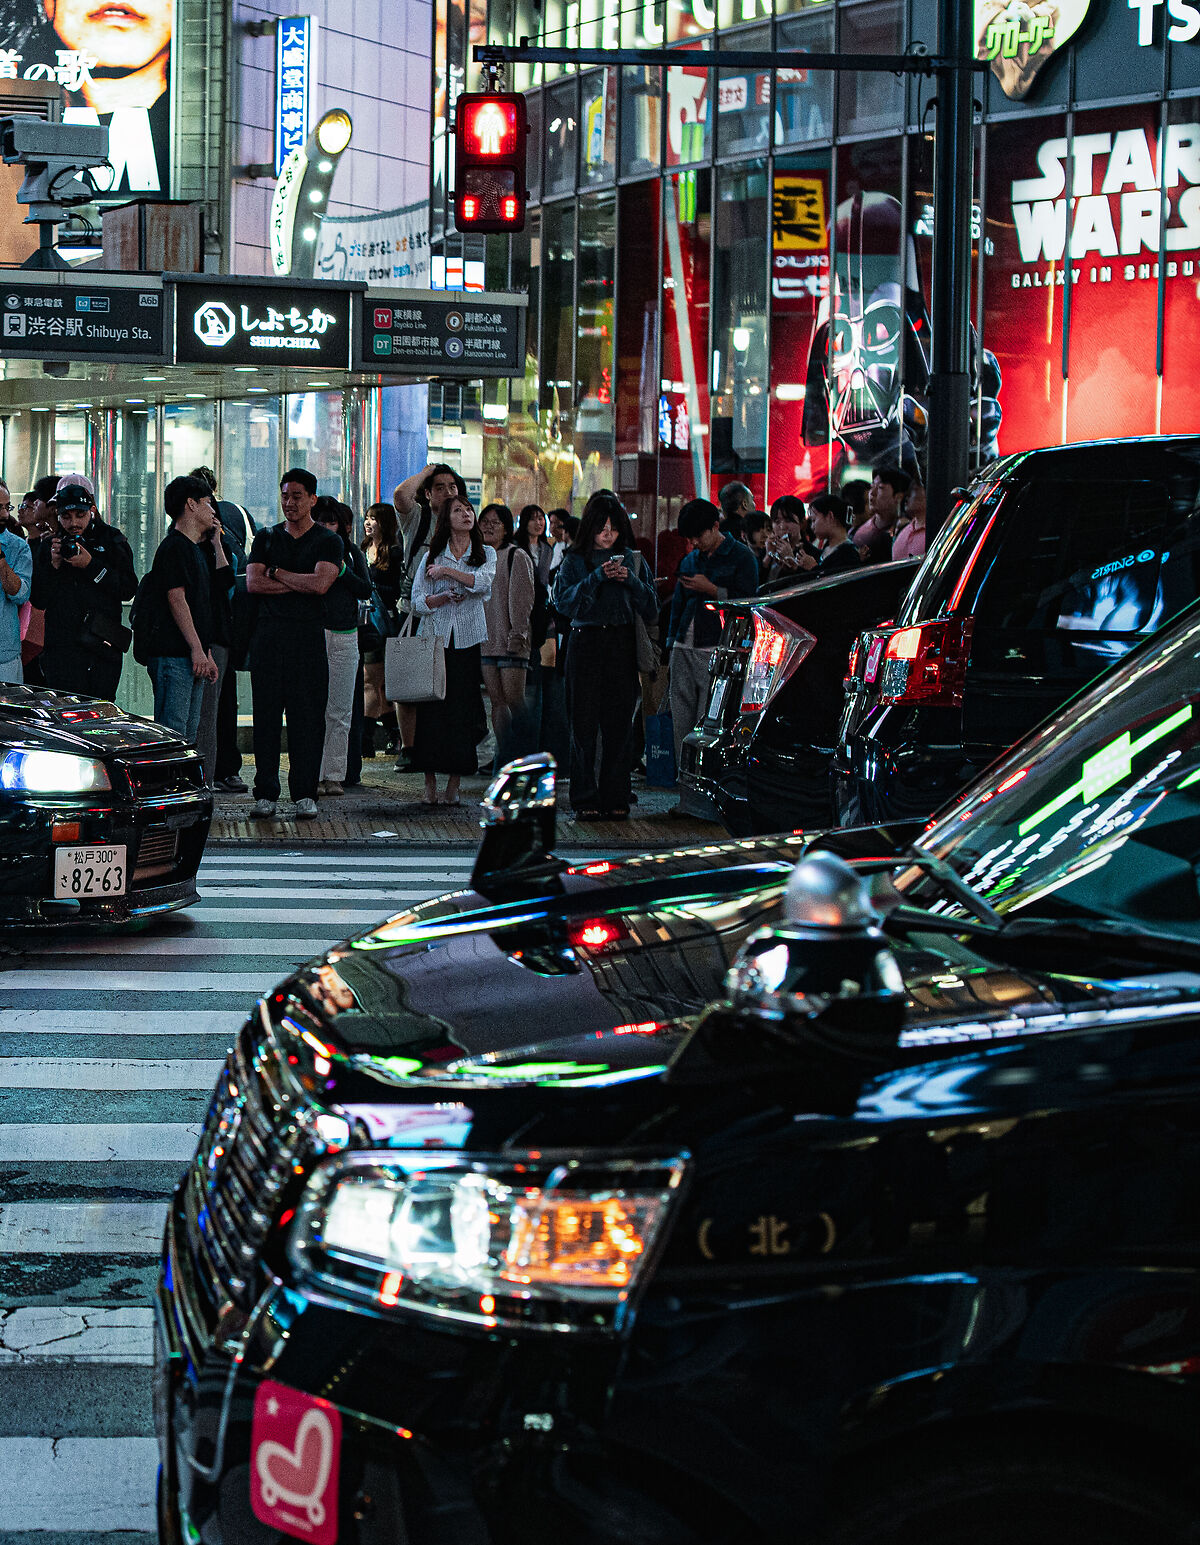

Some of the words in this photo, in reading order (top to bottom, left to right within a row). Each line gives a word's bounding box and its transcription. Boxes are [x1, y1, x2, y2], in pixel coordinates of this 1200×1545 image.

[1012, 123, 1200, 202] STAR
[1012, 186, 1200, 263] WARS
[1011, 269, 1081, 289] GALAXY
[1090, 266, 1112, 283] IN
[1124, 260, 1200, 281] SHIBU
[27, 316, 83, 336] 渋谷駅
[377, 314, 389, 323] TY
[86, 325, 129, 342] Shibuya
[131, 327, 152, 340] Sta.
[376, 340, 389, 349] DT
[71, 866, 123, 893] 82-63
